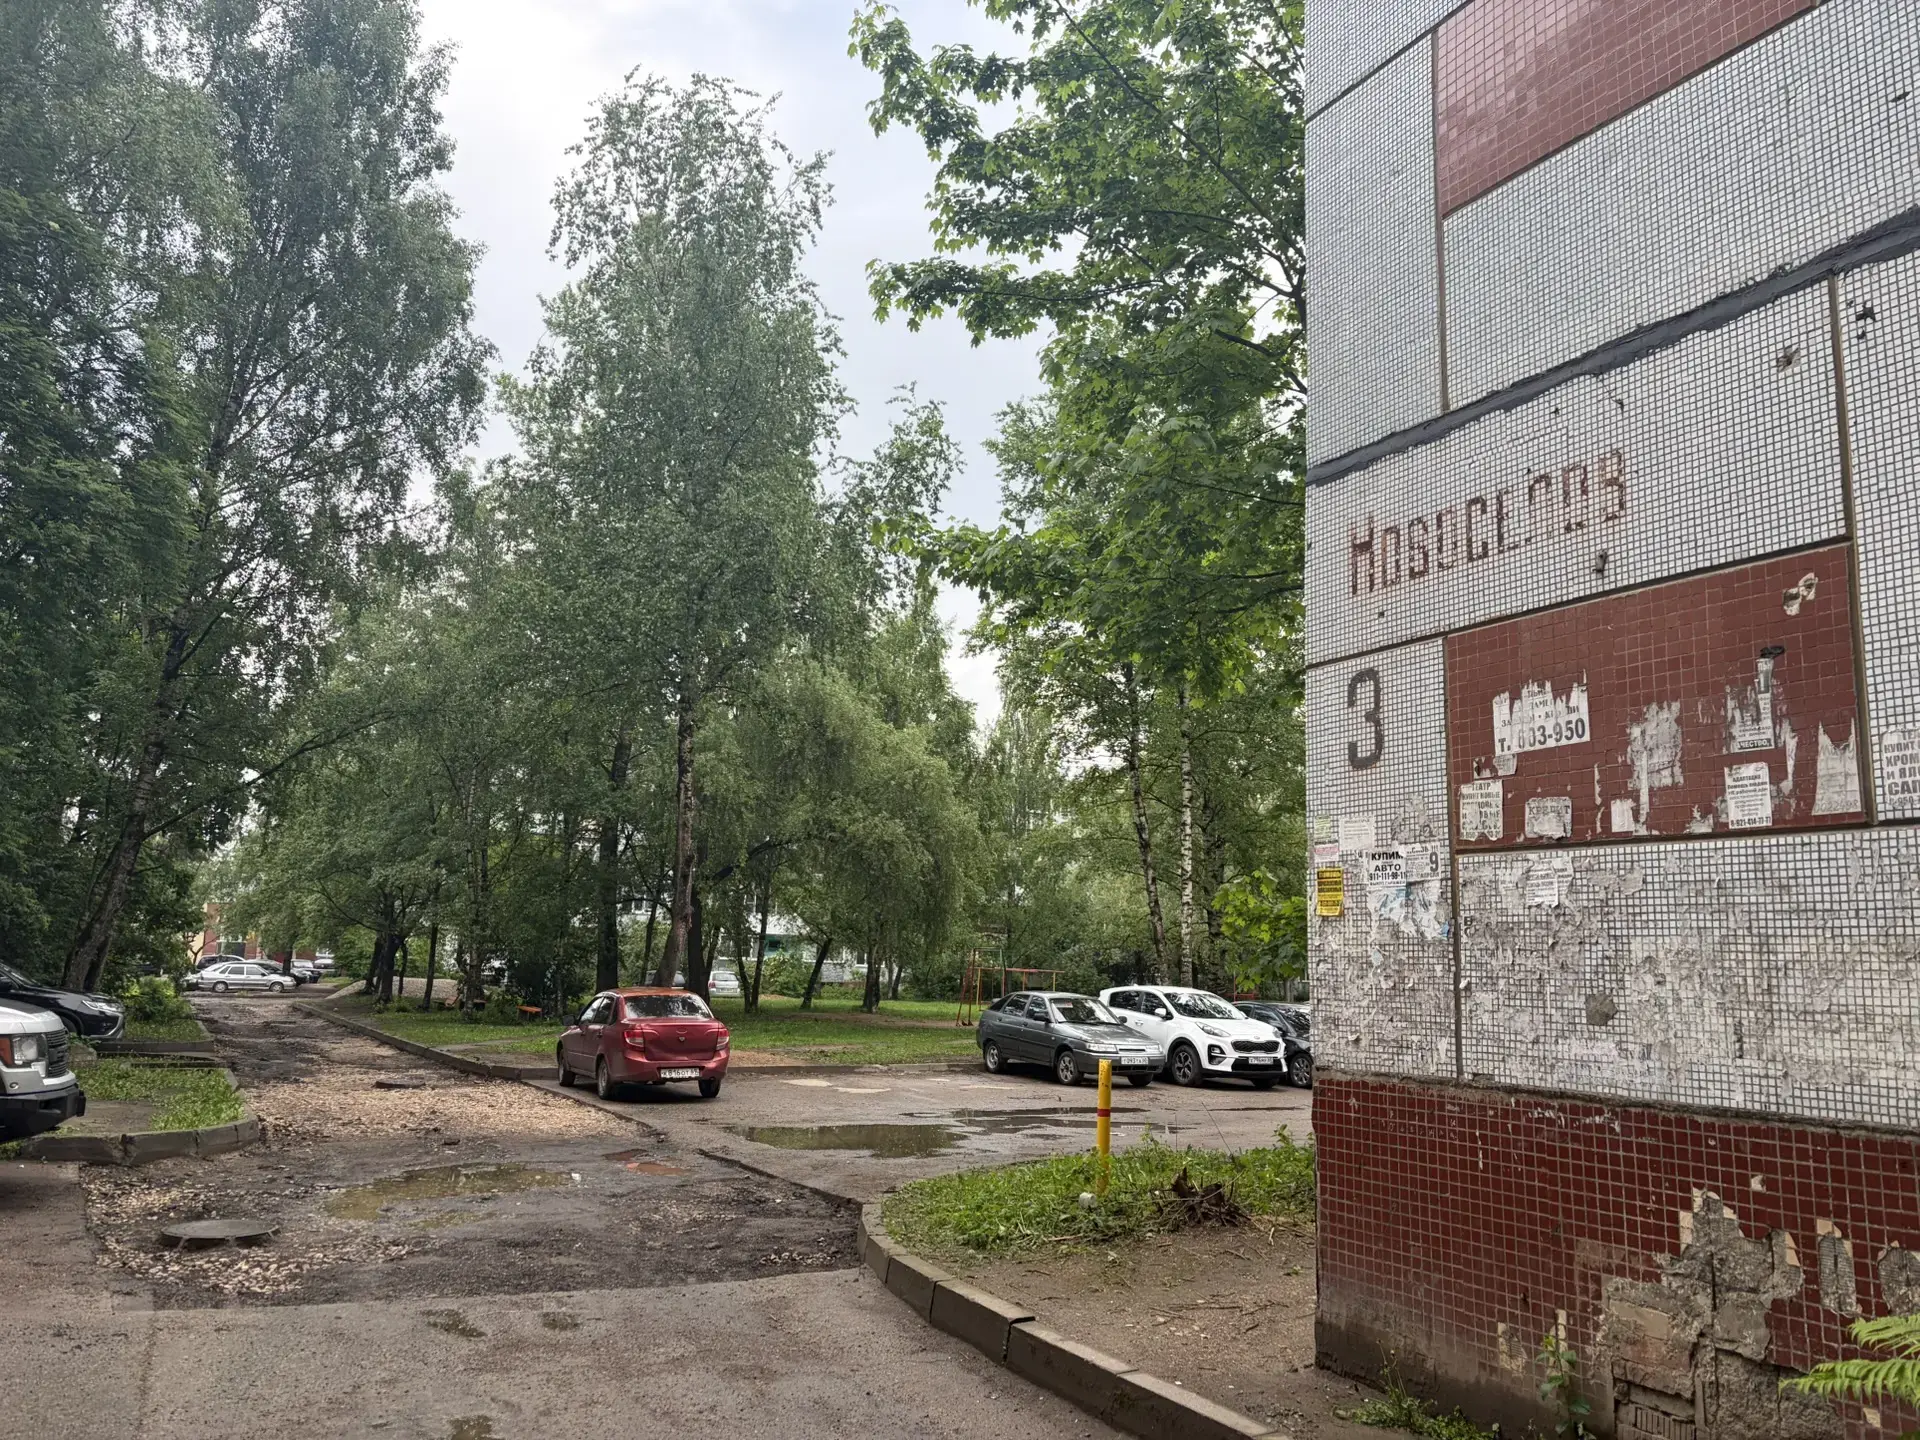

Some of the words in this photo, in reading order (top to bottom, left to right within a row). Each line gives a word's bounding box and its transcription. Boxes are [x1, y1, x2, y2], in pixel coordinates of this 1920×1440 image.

[1348, 667, 1383, 770] 3
[1884, 741, 1915, 753] КУПИТ
[1371, 851, 1404, 861] КУПИМ
[1429, 851, 1439, 873] 9
[1374, 863, 1402, 872] АВТО
